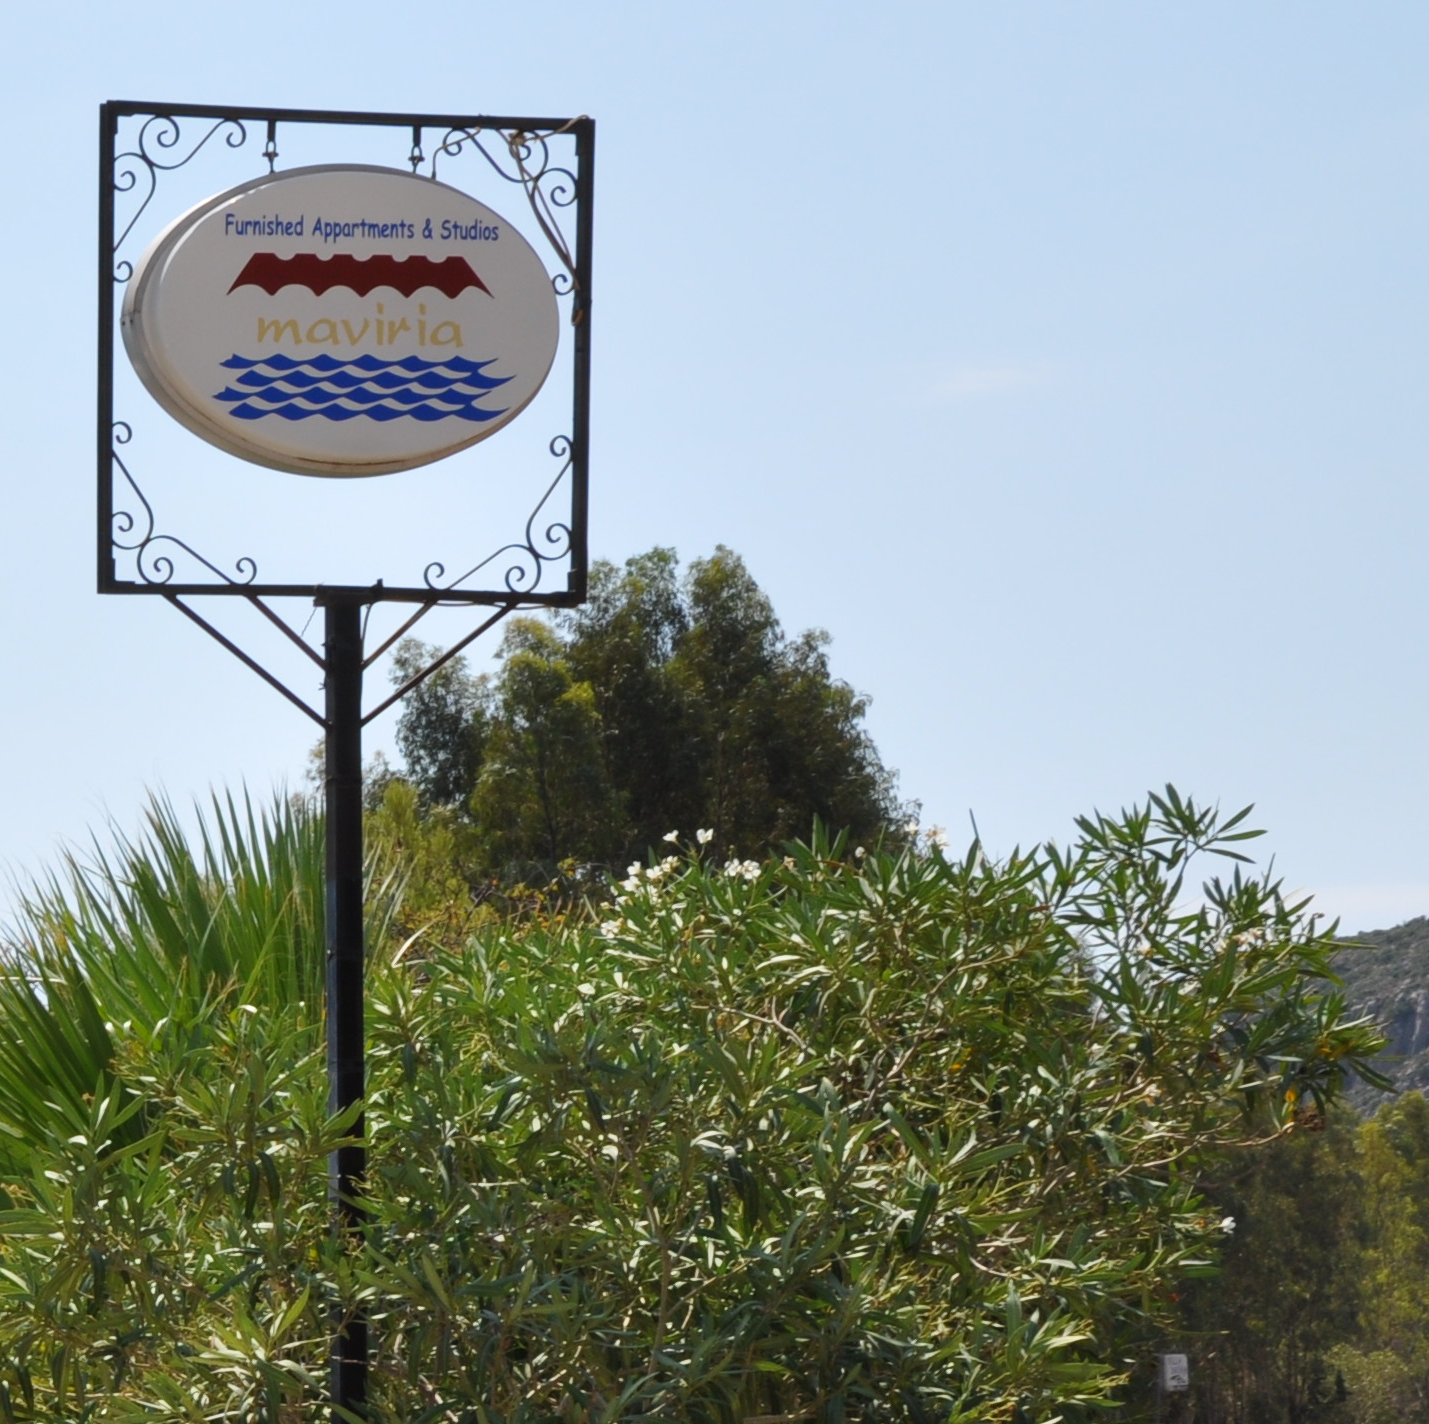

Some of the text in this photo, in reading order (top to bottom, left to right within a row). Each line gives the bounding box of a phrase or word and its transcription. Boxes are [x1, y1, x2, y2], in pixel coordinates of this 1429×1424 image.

[225, 213, 499, 243] Furnished Appartments & Studios
[256, 302, 464, 348] maviria
